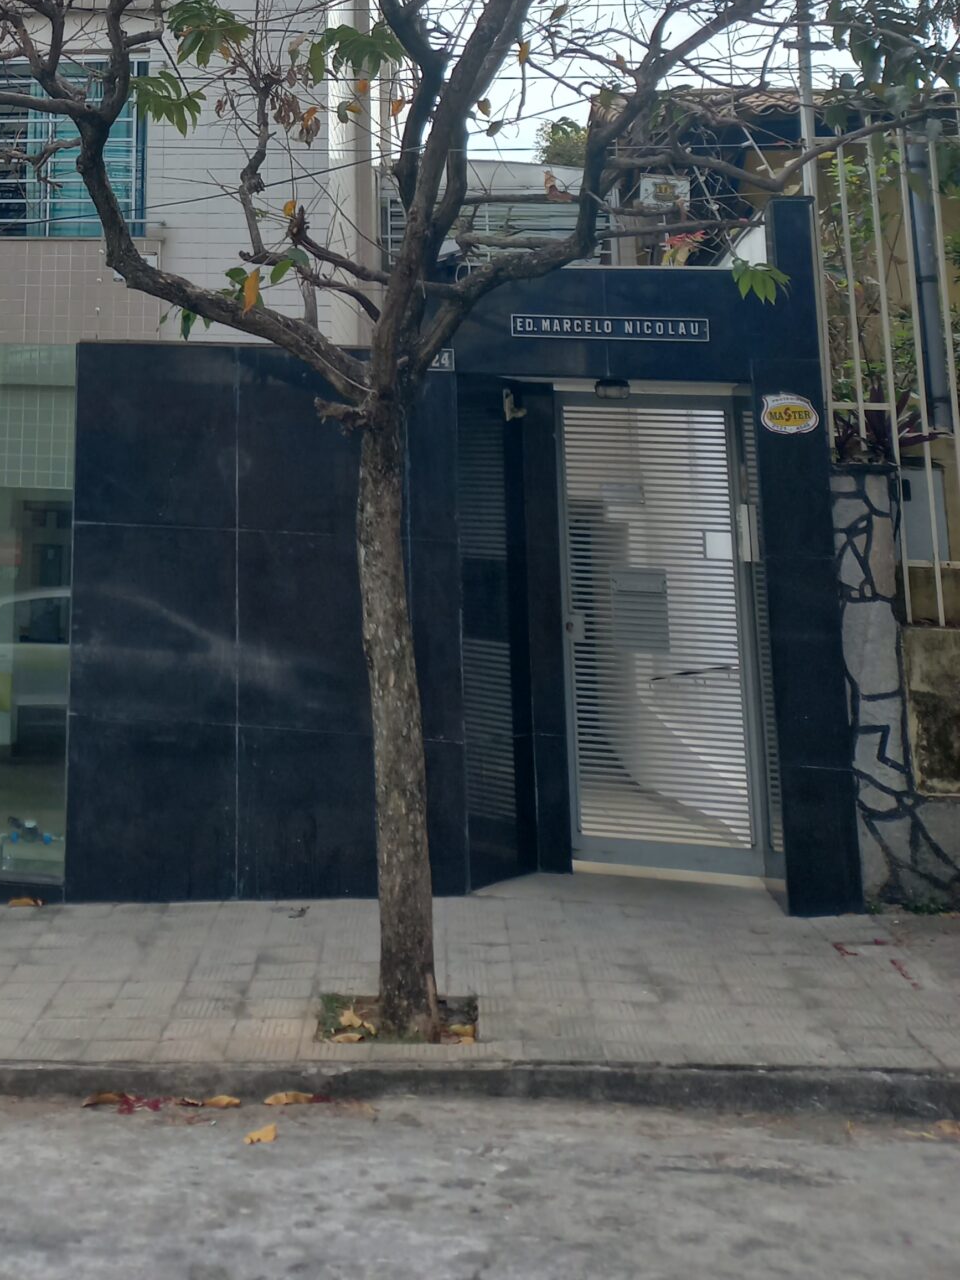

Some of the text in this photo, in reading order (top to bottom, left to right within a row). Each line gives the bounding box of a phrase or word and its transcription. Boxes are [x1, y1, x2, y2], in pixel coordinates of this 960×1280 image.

[516, 318, 700, 336] ED. MARCELO NICOLAU
[769, 407, 811, 422] MASTER
